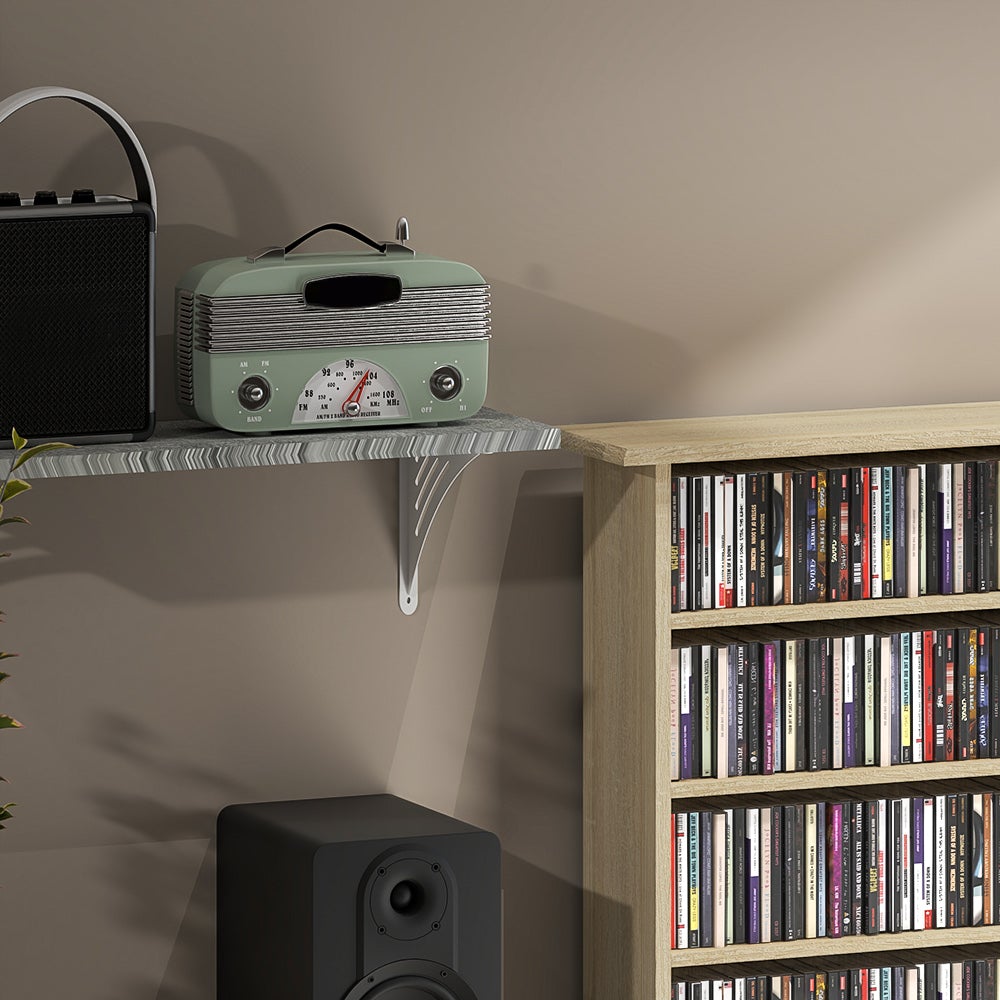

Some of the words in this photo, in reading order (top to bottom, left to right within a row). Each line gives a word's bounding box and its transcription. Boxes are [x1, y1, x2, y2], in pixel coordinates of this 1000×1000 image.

[345, 359, 355, 368] 96
[322, 368, 331, 376] 92
[305, 389, 313, 397] 88
[382, 390, 394, 398] 108
